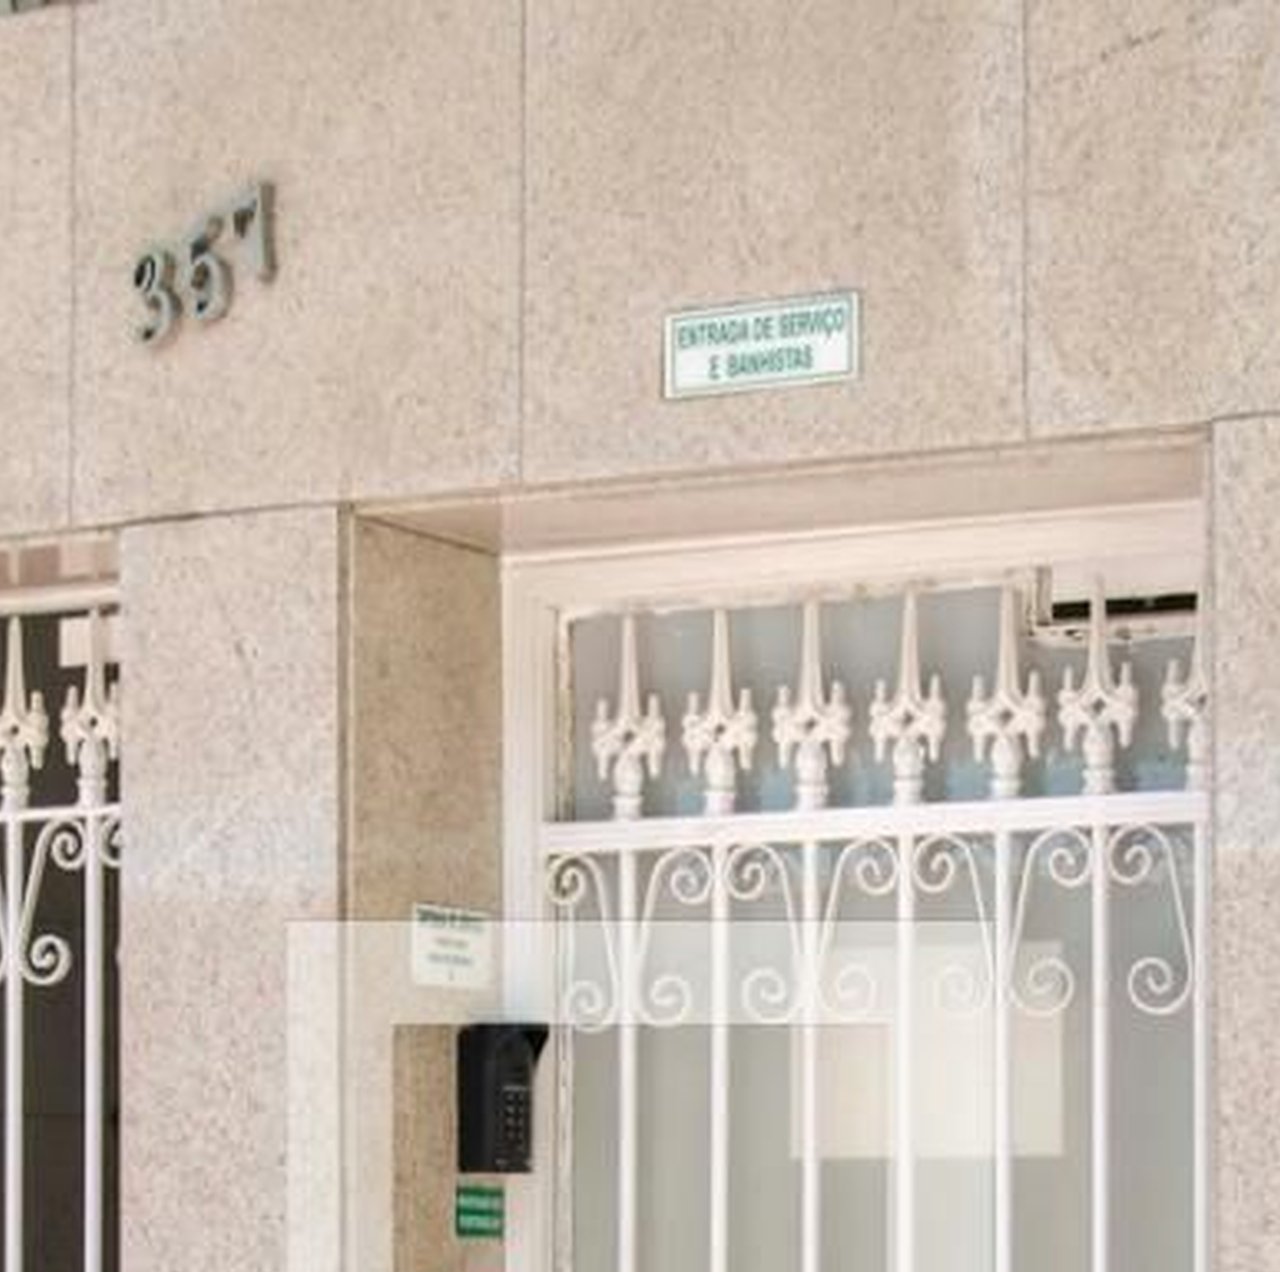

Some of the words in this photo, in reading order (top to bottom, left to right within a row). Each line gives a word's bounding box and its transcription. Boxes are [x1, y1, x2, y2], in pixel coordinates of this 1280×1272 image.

[132, 180, 278, 347] 357
[677, 318, 749, 350] ENTRADA
[753, 315, 776, 342] DE
[780, 306, 845, 339] SERVIÇO
[707, 353, 721, 380] E
[726, 345, 814, 379] BANHISTAS
